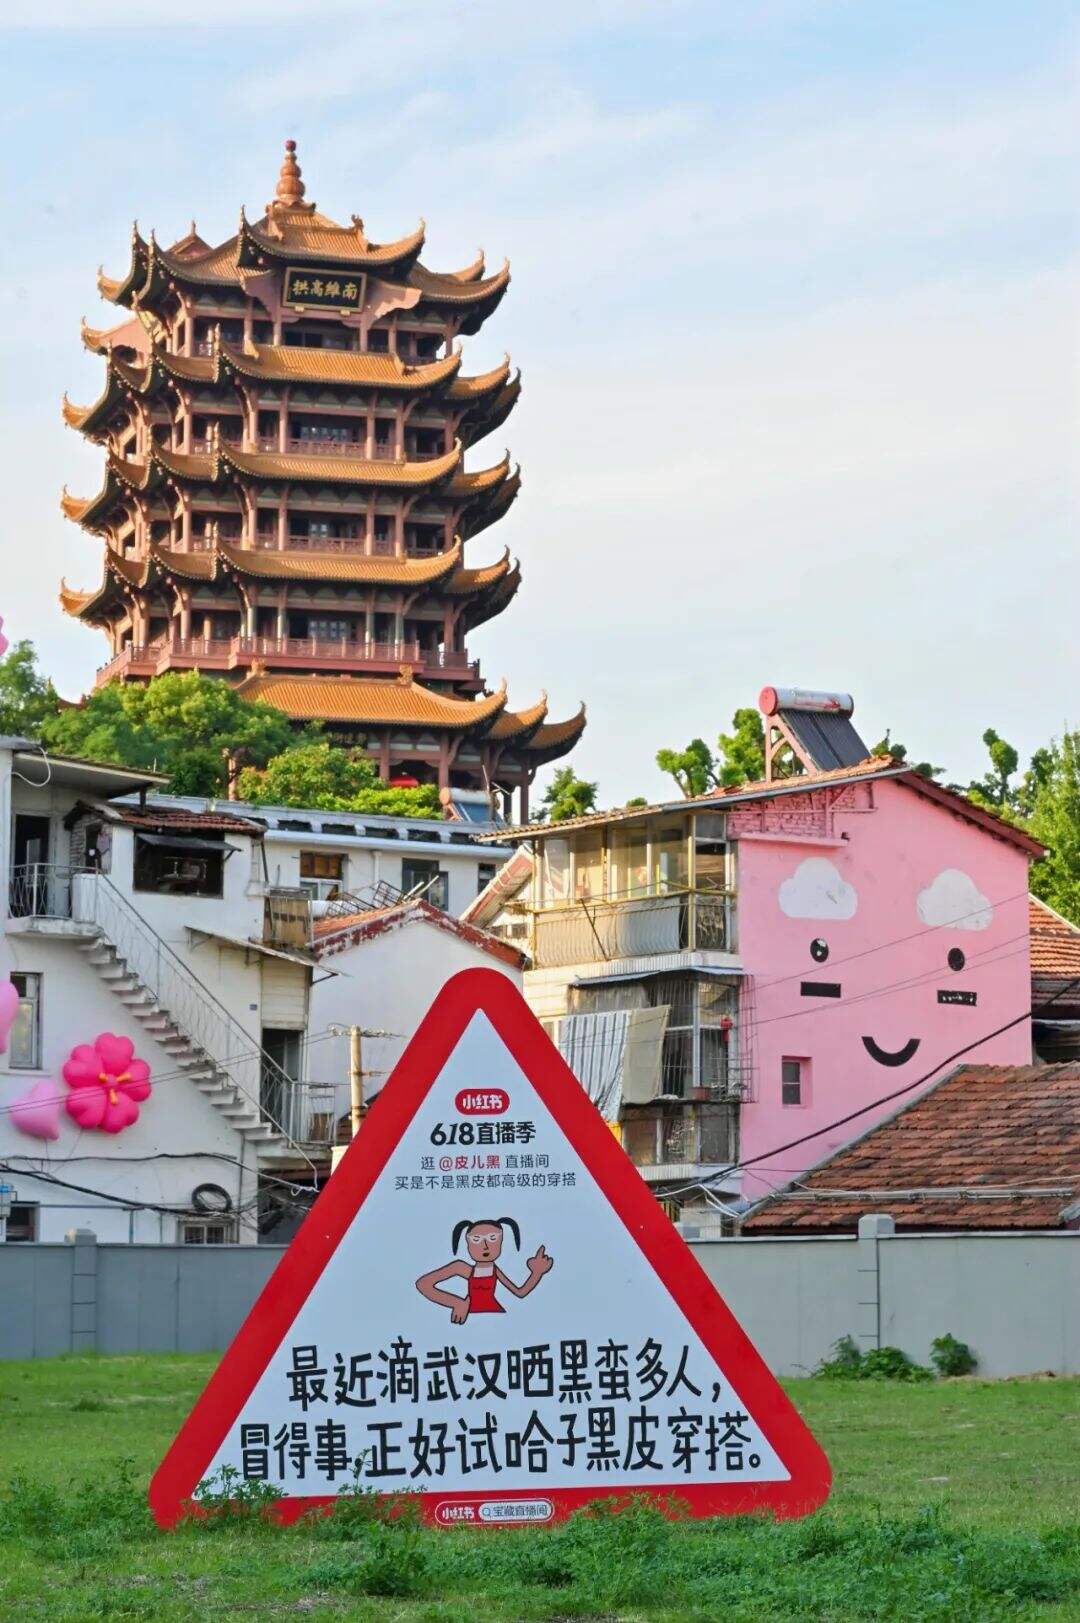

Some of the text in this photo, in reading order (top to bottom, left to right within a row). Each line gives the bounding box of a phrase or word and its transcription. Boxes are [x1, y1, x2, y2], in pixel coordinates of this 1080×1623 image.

[462, 1094, 503, 1110] 小红书
[430, 1121, 537, 1146] 618直播季
[421, 1154, 549, 1171] 逛 @皮儿黑 直播间
[395, 1172, 577, 1190] 买是不是黑皮都高级的穿搭
[286, 1336, 722, 1412] 最近滴武汉晒黑蛮多人，
[442, 1506, 474, 1519] 小红书
